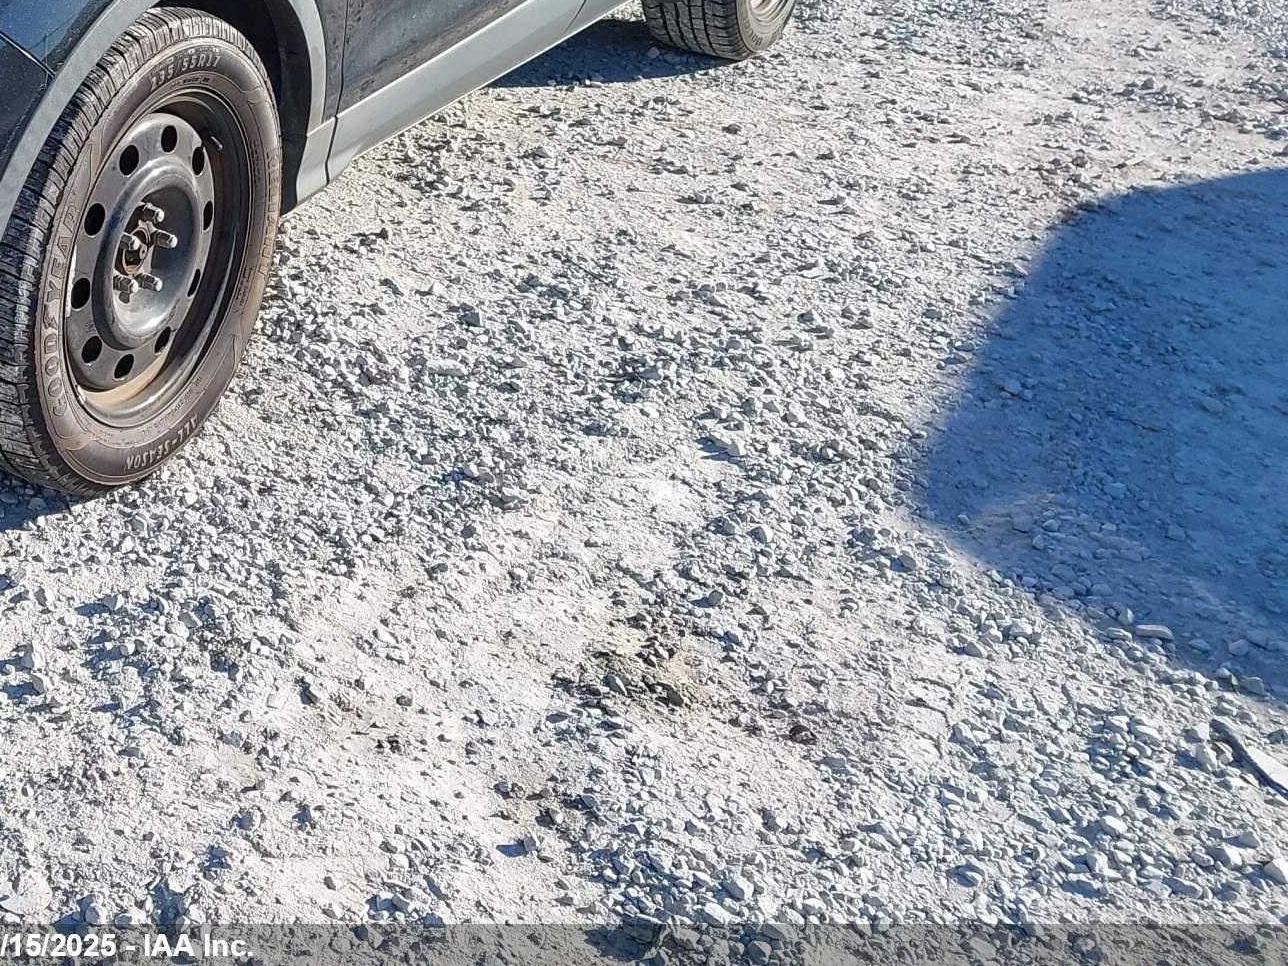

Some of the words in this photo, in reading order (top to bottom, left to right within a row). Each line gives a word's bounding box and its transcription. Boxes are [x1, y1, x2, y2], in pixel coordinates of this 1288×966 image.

[150, 52, 221, 92] 235/55R17
[42, 204, 78, 418] GOODYEAR
[124, 413, 199, 470] ALL-SEASON
